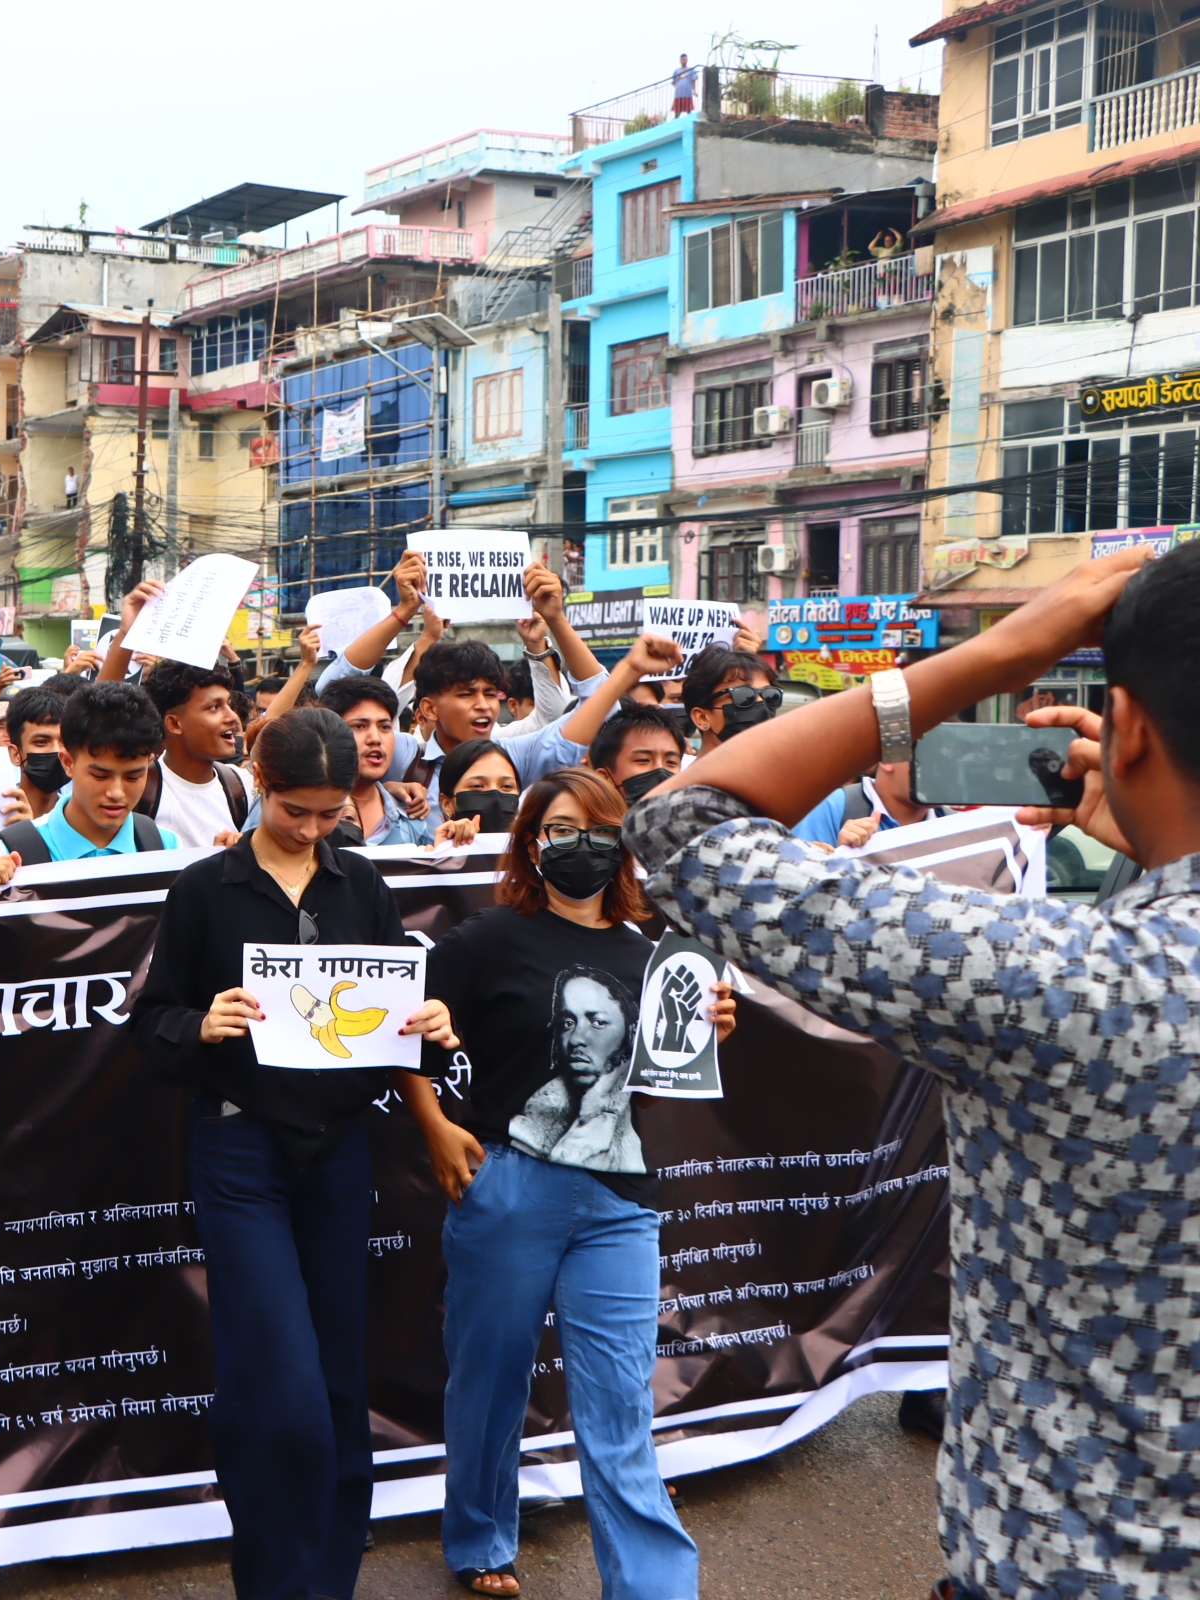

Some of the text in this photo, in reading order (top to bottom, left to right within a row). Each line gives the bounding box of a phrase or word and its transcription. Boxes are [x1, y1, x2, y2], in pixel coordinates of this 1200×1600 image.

[1101, 377, 1158, 412] सयपत्री
[437, 551, 465, 570] RISE,
[468, 551, 485, 567] WE
[489, 552, 524, 567] RESIST
[449, 573, 523, 598] RECLAIM
[604, 600, 634, 624] LIGHT
[649, 606, 684, 626] WAKE
[688, 608, 703, 627] UP
[768, 600, 801, 624] होटल
[803, 598, 841, 622] मितेरी
[671, 631, 714, 649] TIME TO
[838, 649, 892, 664] मितेरी
[250, 948, 419, 980] केरा गणतन्त्र
[665, 1160, 713, 1180] राजनीतिक
[716, 1153, 775, 1173] नेताहरूको
[779, 1151, 820, 1168] सम्पत्ति
[825, 1149, 871, 1167] छानबिन
[677, 1210, 691, 1223] ३०
[694, 1200, 733, 1220] दिनभित्र
[736, 1199, 784, 1215] समाधान
[788, 1192, 829, 1216] गर्नुपर्छ
[834, 1196, 841, 1208] र
[874, 1178, 903, 1197] विवरण
[5, 1210, 84, 1234] न्यायपालिका
[89, 1210, 97, 1223] र
[102, 1202, 179, 1222] अख्तियारमा
[20, 1258, 76, 1282] जनताको
[80, 1256, 119, 1279] सुझाव
[123, 1254, 131, 1269] र
[135, 1246, 206, 1267] सार्वजनिक
[671, 1248, 709, 1272] सुनिश्चित
[712, 1239, 762, 1262] गरिनुपर्छ।
[736, 1282, 789, 1301] अधिकार)
[792, 1279, 825, 1293] कायम
[706, 1330, 739, 1350] प्रतिबन्ध
[65, 1357, 95, 1373] चयन
[100, 1345, 167, 1372] गरिनुपर्छ।
[16, 1414, 36, 1429] ६५
[40, 1404, 63, 1426] वर्ष
[68, 1400, 116, 1422] उमेरको
[121, 1398, 155, 1416] सिमा
